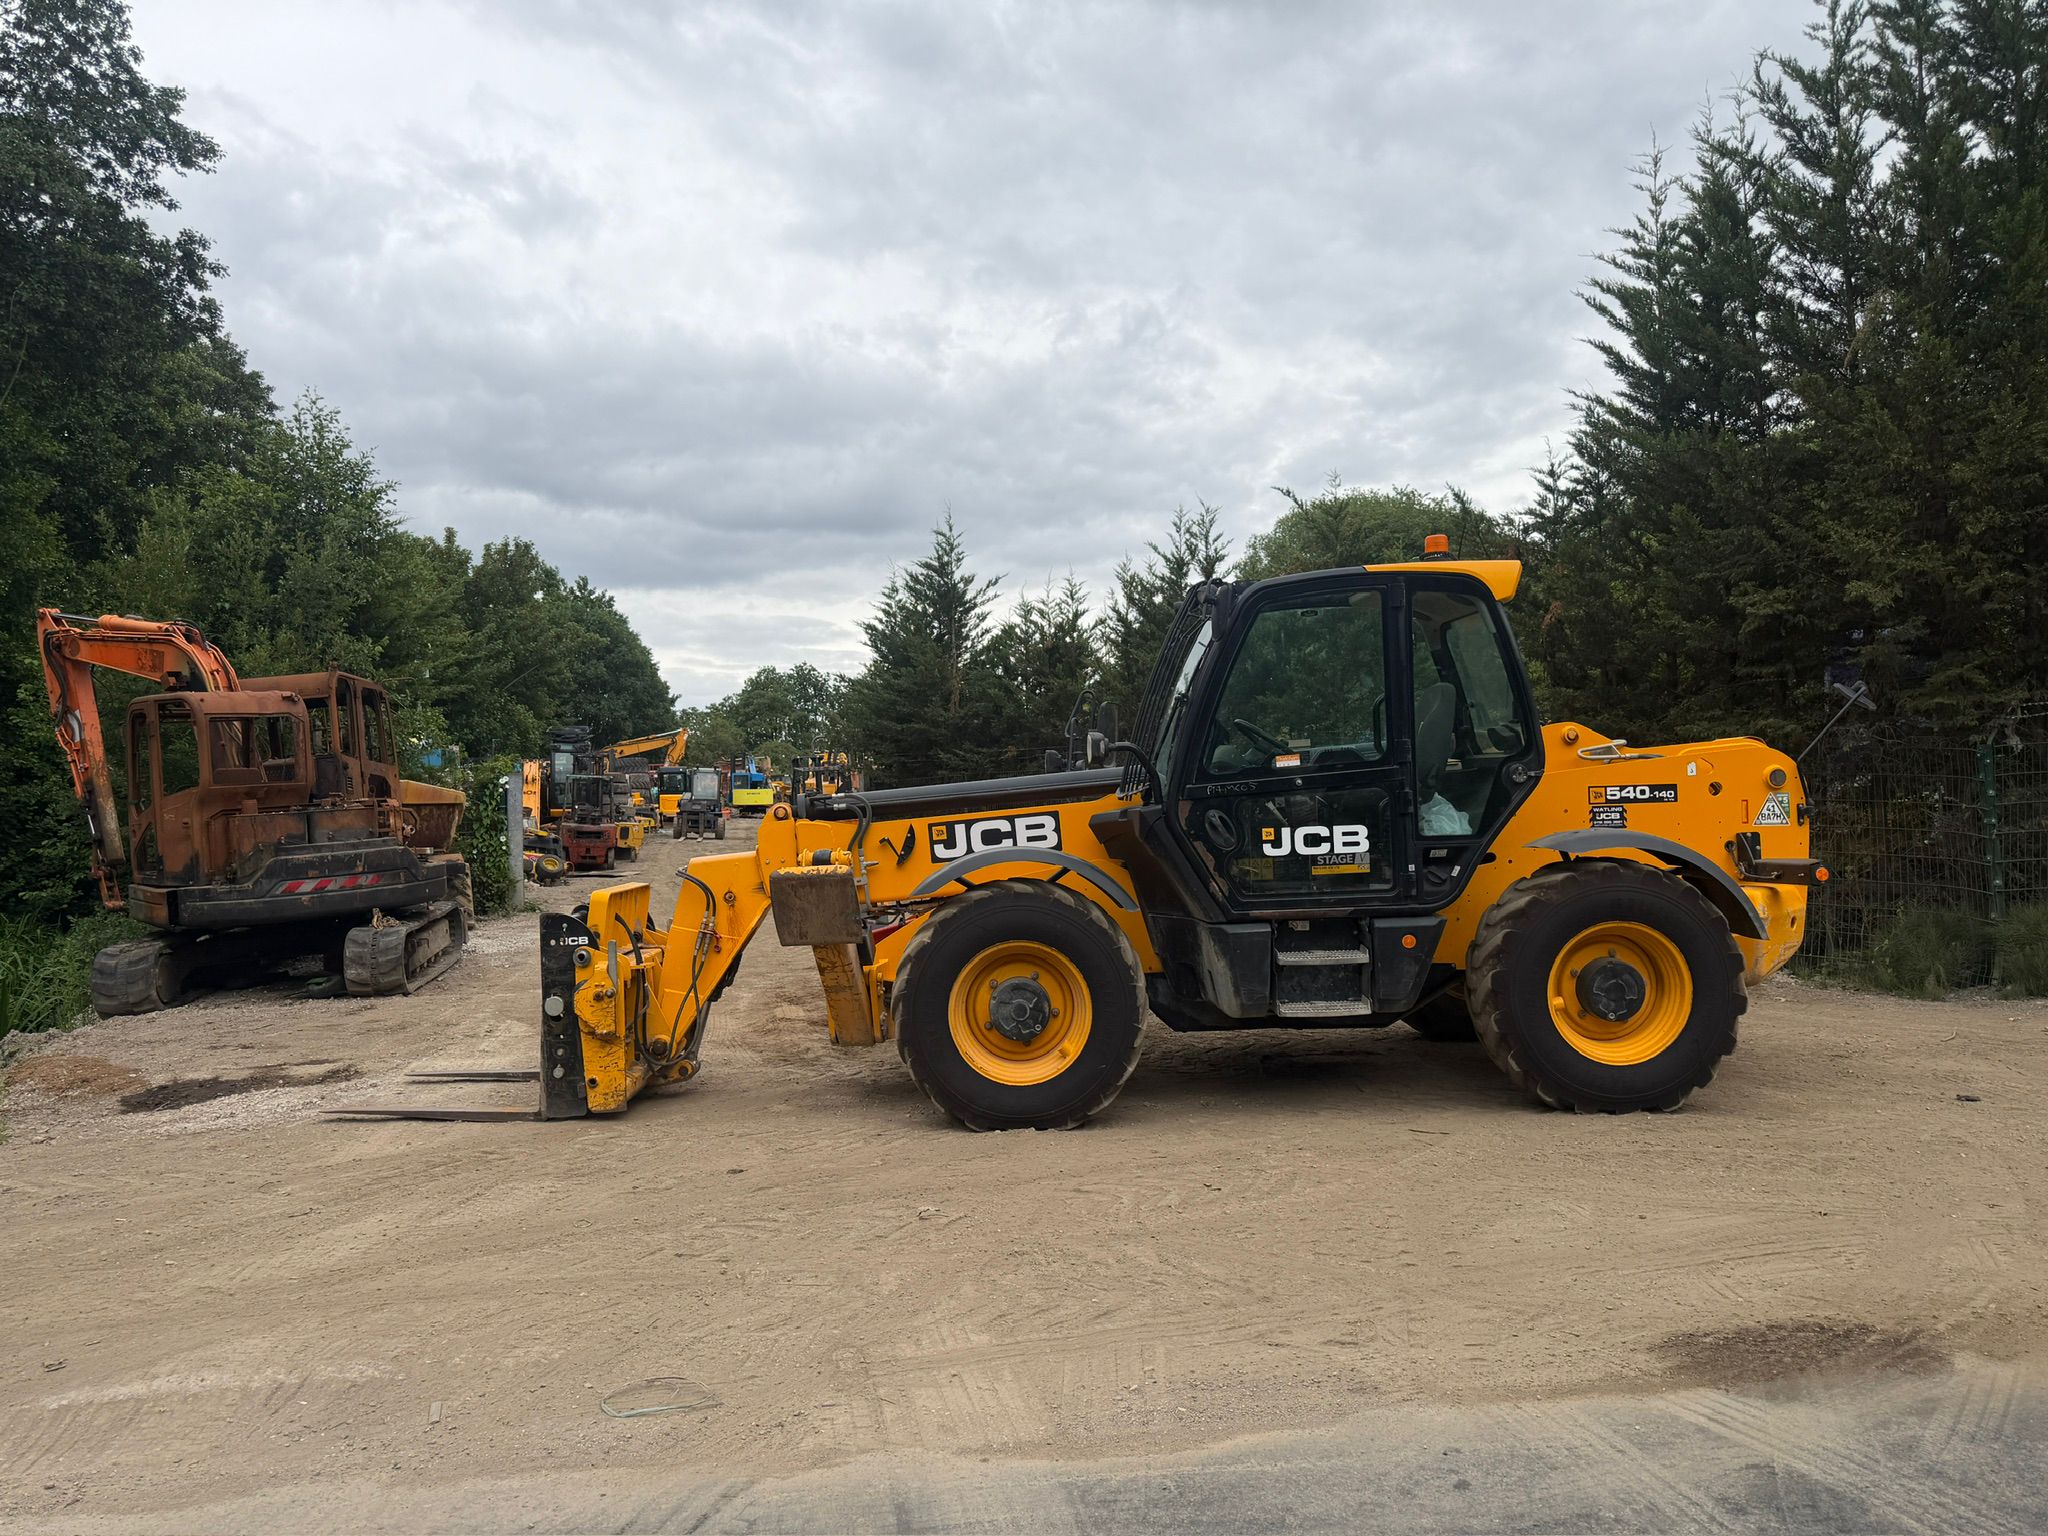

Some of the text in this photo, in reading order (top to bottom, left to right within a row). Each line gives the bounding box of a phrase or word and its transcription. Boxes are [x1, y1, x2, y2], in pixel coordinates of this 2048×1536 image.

[1606, 786, 1675, 800] 540-140
[1766, 804, 1776, 813] 41
[1596, 812, 1620, 820] JCB
[933, 815, 1059, 859] JCB
[1262, 825, 1370, 857] JCB
[1317, 854, 1354, 865] STAGE
[560, 937, 589, 946] JCB
